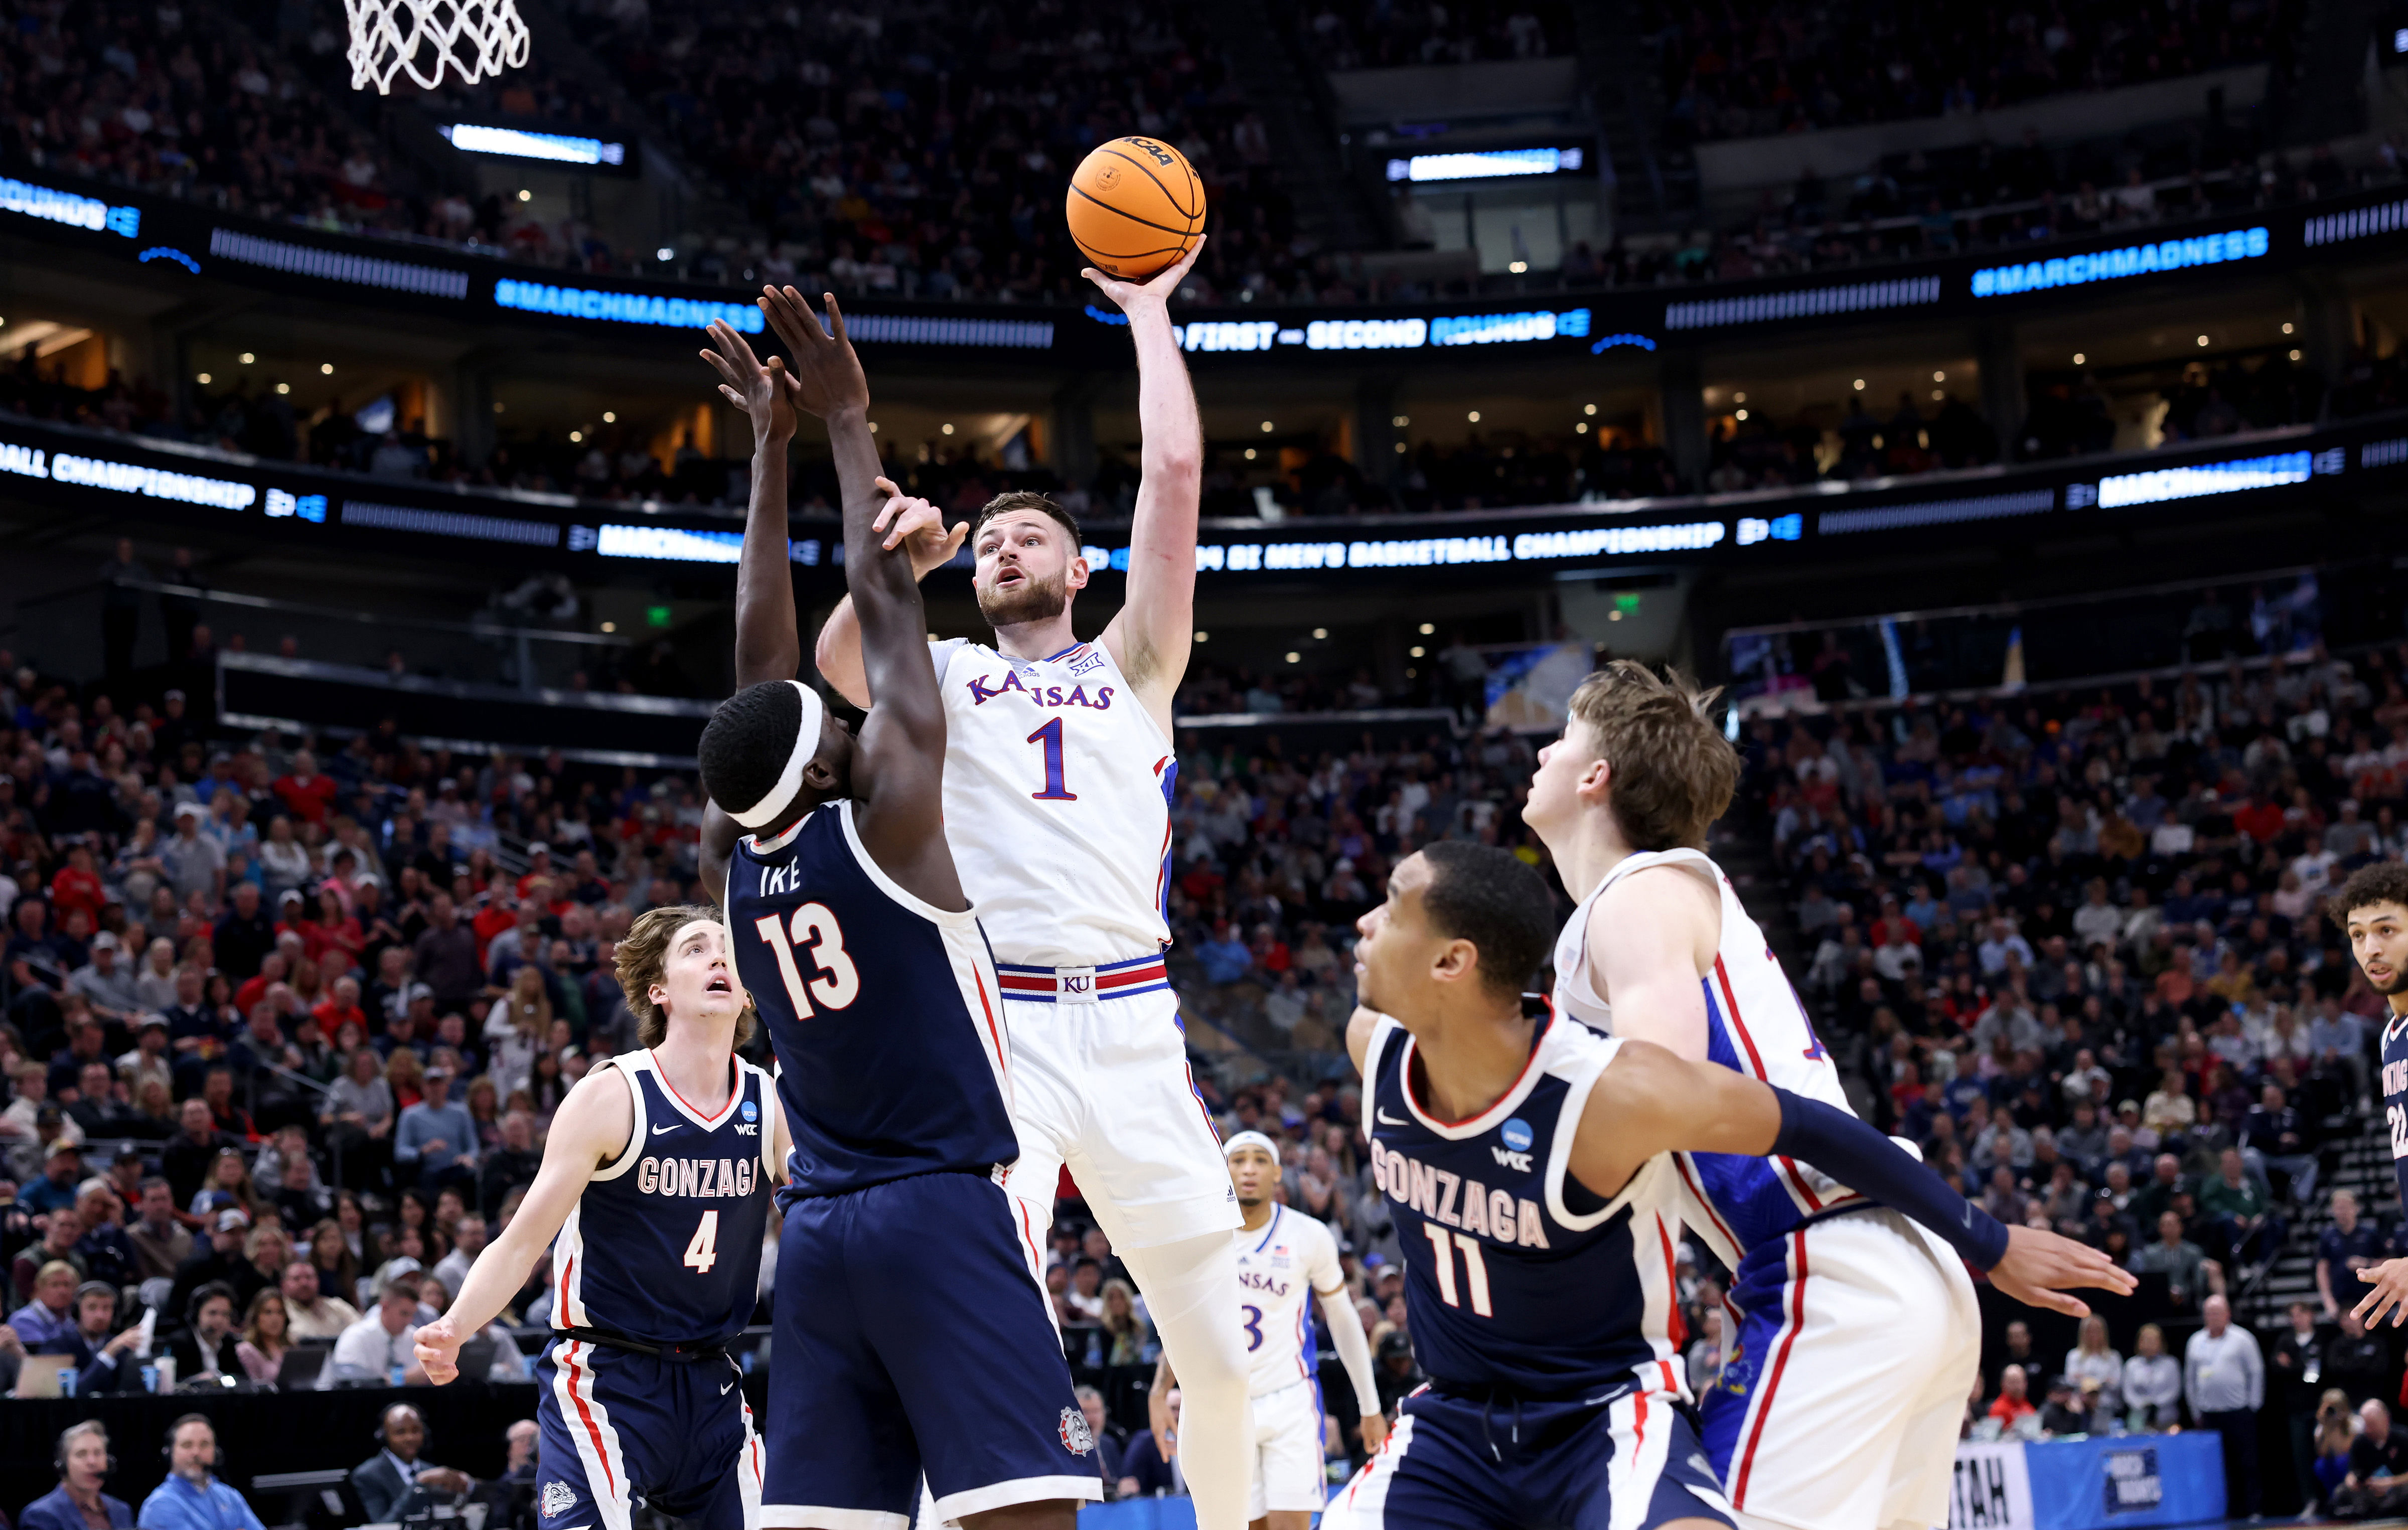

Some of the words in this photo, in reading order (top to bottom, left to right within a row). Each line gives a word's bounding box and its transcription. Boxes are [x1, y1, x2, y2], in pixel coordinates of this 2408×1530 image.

[1971, 227, 2269, 297] #MARCHMADNESS
[494, 277, 765, 334] #MARCHMADNESS
[1185, 321, 1279, 351] FIRST
[1306, 318, 1427, 350] SECOND
[51, 452, 255, 511] CHAMPIONSHIP
[1347, 535, 1512, 568] BASKETBALL
[1514, 522, 1725, 560] CHAMPIONSHIP
[967, 670, 1115, 710] KANSAS
[1027, 716, 1078, 801] 1
[760, 855, 801, 898] IKE
[754, 901, 861, 1021] 13
[1063, 976, 1091, 994] KU
[1371, 1137, 1551, 1249] GONZAGA
[684, 1209, 718, 1274] 4
[1423, 1220, 1493, 1319] 11
[1239, 1273, 1290, 1297] NSAS
